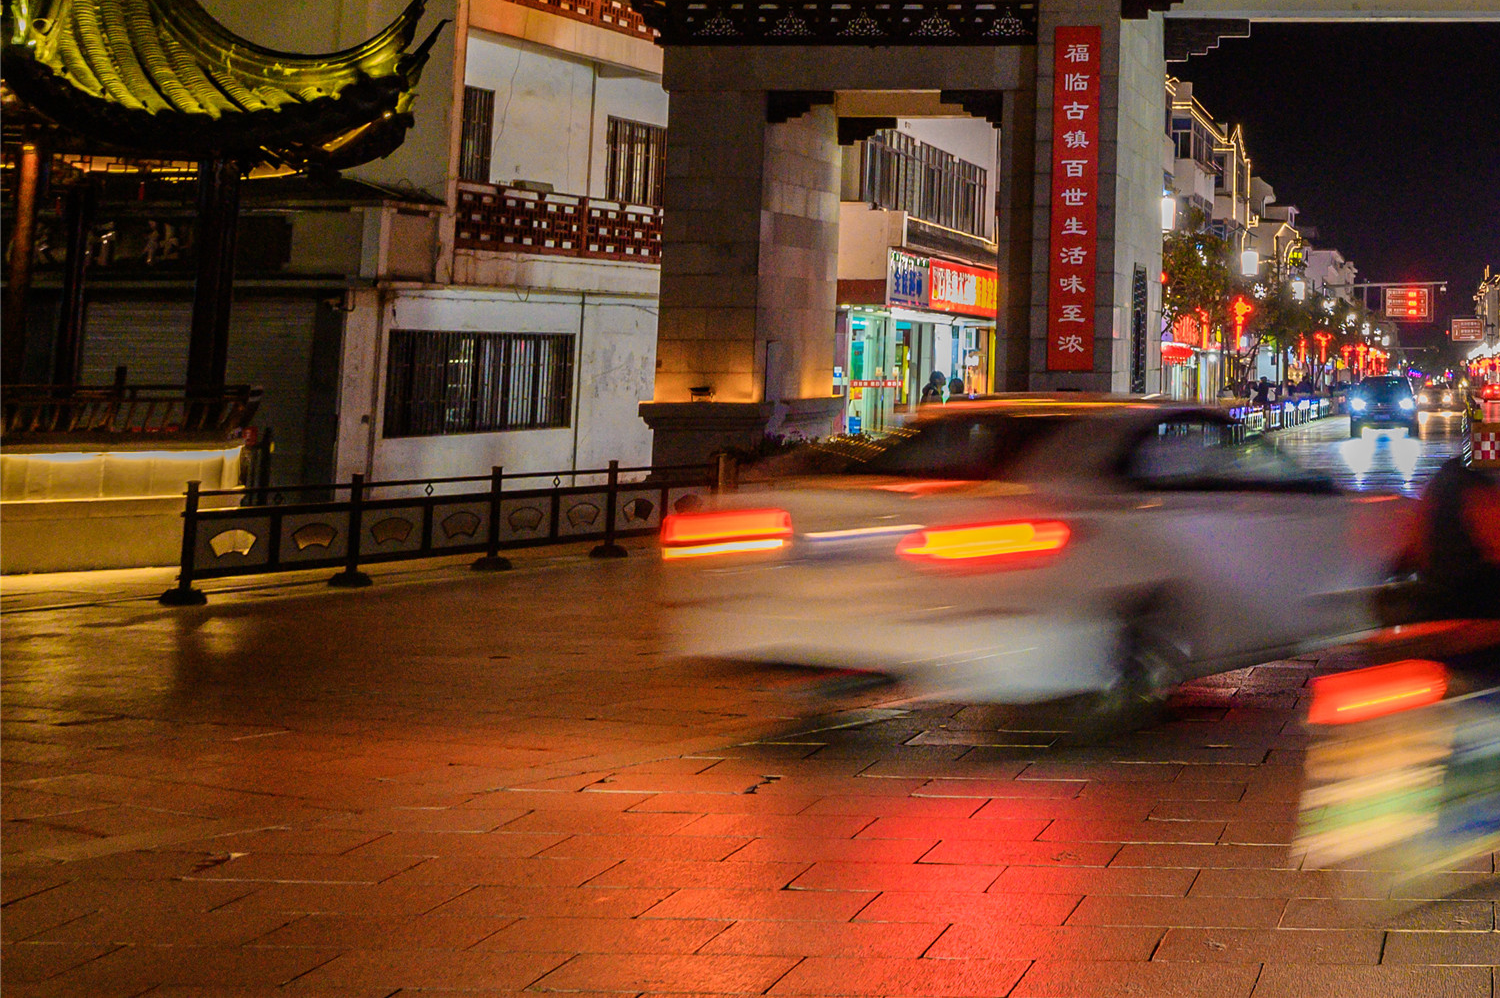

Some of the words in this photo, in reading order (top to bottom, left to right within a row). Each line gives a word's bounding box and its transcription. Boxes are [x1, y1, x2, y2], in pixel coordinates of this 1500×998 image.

[1058, 43, 1090, 354] 福临古镇百世生活味至浓
